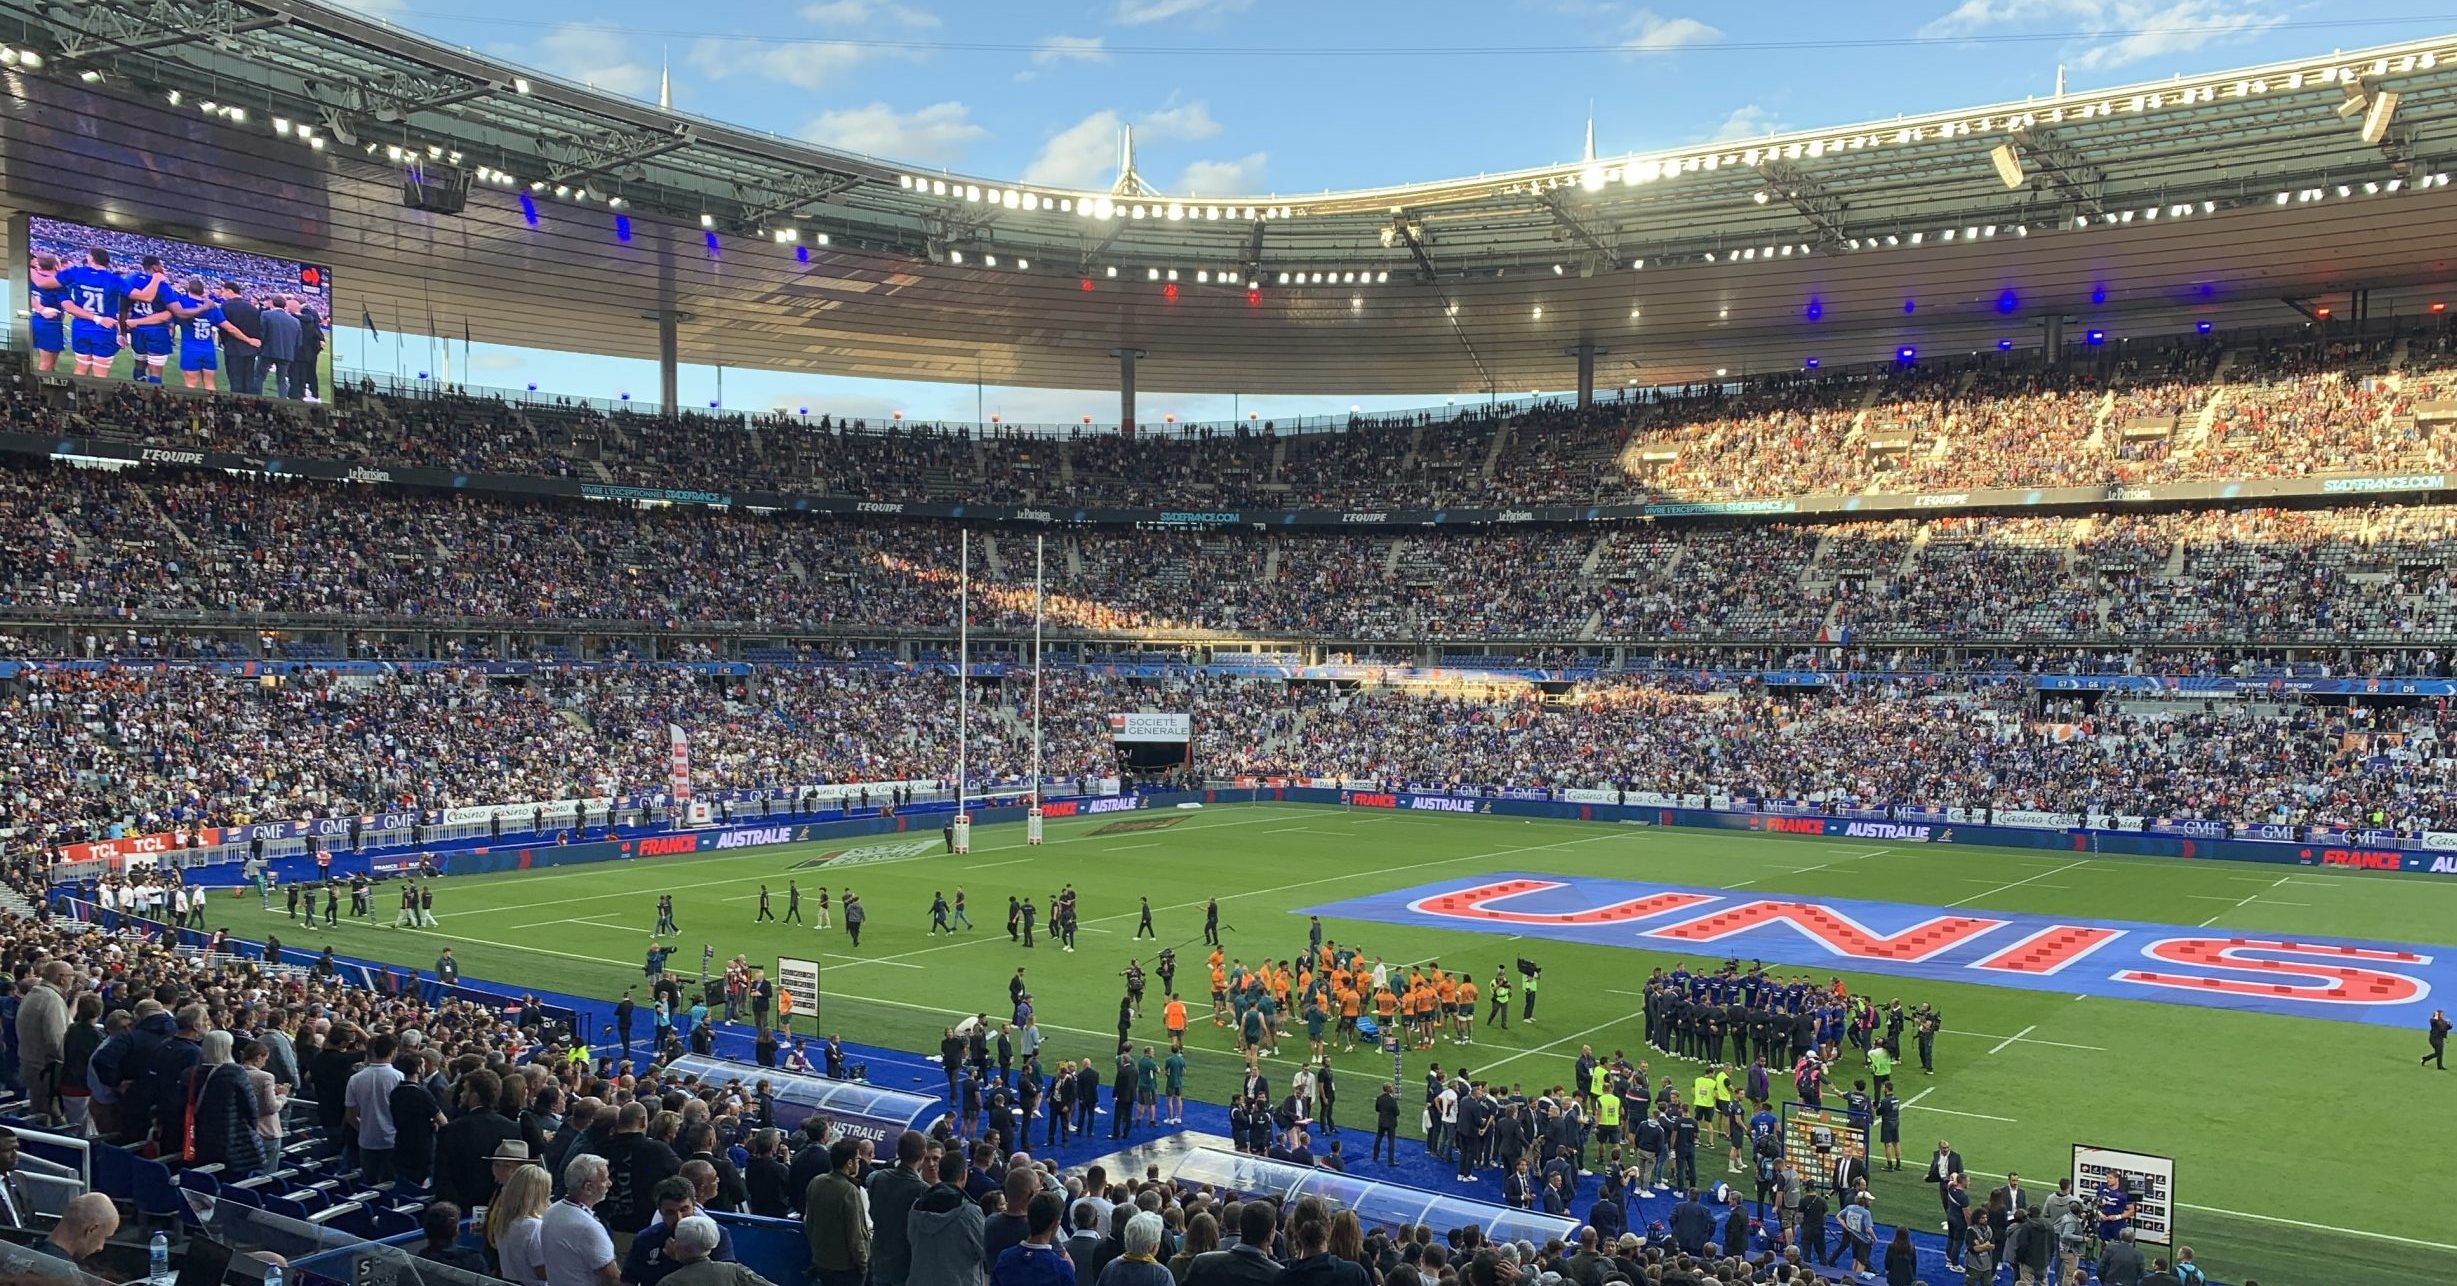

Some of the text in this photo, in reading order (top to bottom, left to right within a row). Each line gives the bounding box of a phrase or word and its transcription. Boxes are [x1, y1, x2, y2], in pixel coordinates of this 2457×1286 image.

[82, 291, 104, 314] 21
[193, 322, 211, 339] 15
[581, 485, 602, 495] VIVRE
[604, 487, 663, 499] L'EXCEPTIONNEL
[1645, 506, 1666, 514] VIVRE
[2367, 685, 2378, 693] G5
[2403, 685, 2415, 693] D5
[1129, 718, 1177, 727] SOCIETE
[1128, 727, 1188, 735] GENERALE
[1040, 801, 1077, 817] FRANCE
[1088, 797, 1138, 813] AUSTRALIE
[1353, 793, 1396, 808] FRANCE
[1411, 797, 1475, 812] AUSTRALIE
[384, 813, 415, 829] GMF
[447, 810, 486, 822] Casino
[1998, 811, 2043, 825] Casino
[253, 824, 285, 839] GMF
[320, 818, 352, 835] GMF
[1766, 819, 1824, 835] FRANCE
[1845, 822, 1931, 839] AUSTRALIE
[2183, 821, 2220, 835] GMF
[133, 837, 165, 852] TCL
[638, 835, 697, 856] FRANCE
[716, 827, 791, 849] AUSTRALIE
[89, 843, 119, 859] TCL
[2322, 851, 2402, 870] FRANCE
[1406, 878, 2434, 1006] UNIS
[1798, 1111, 1850, 1124] FRANCE RUGBY
[832, 1121, 886, 1141] USTRALIE
[1758, 1123, 1769, 1133] 12
